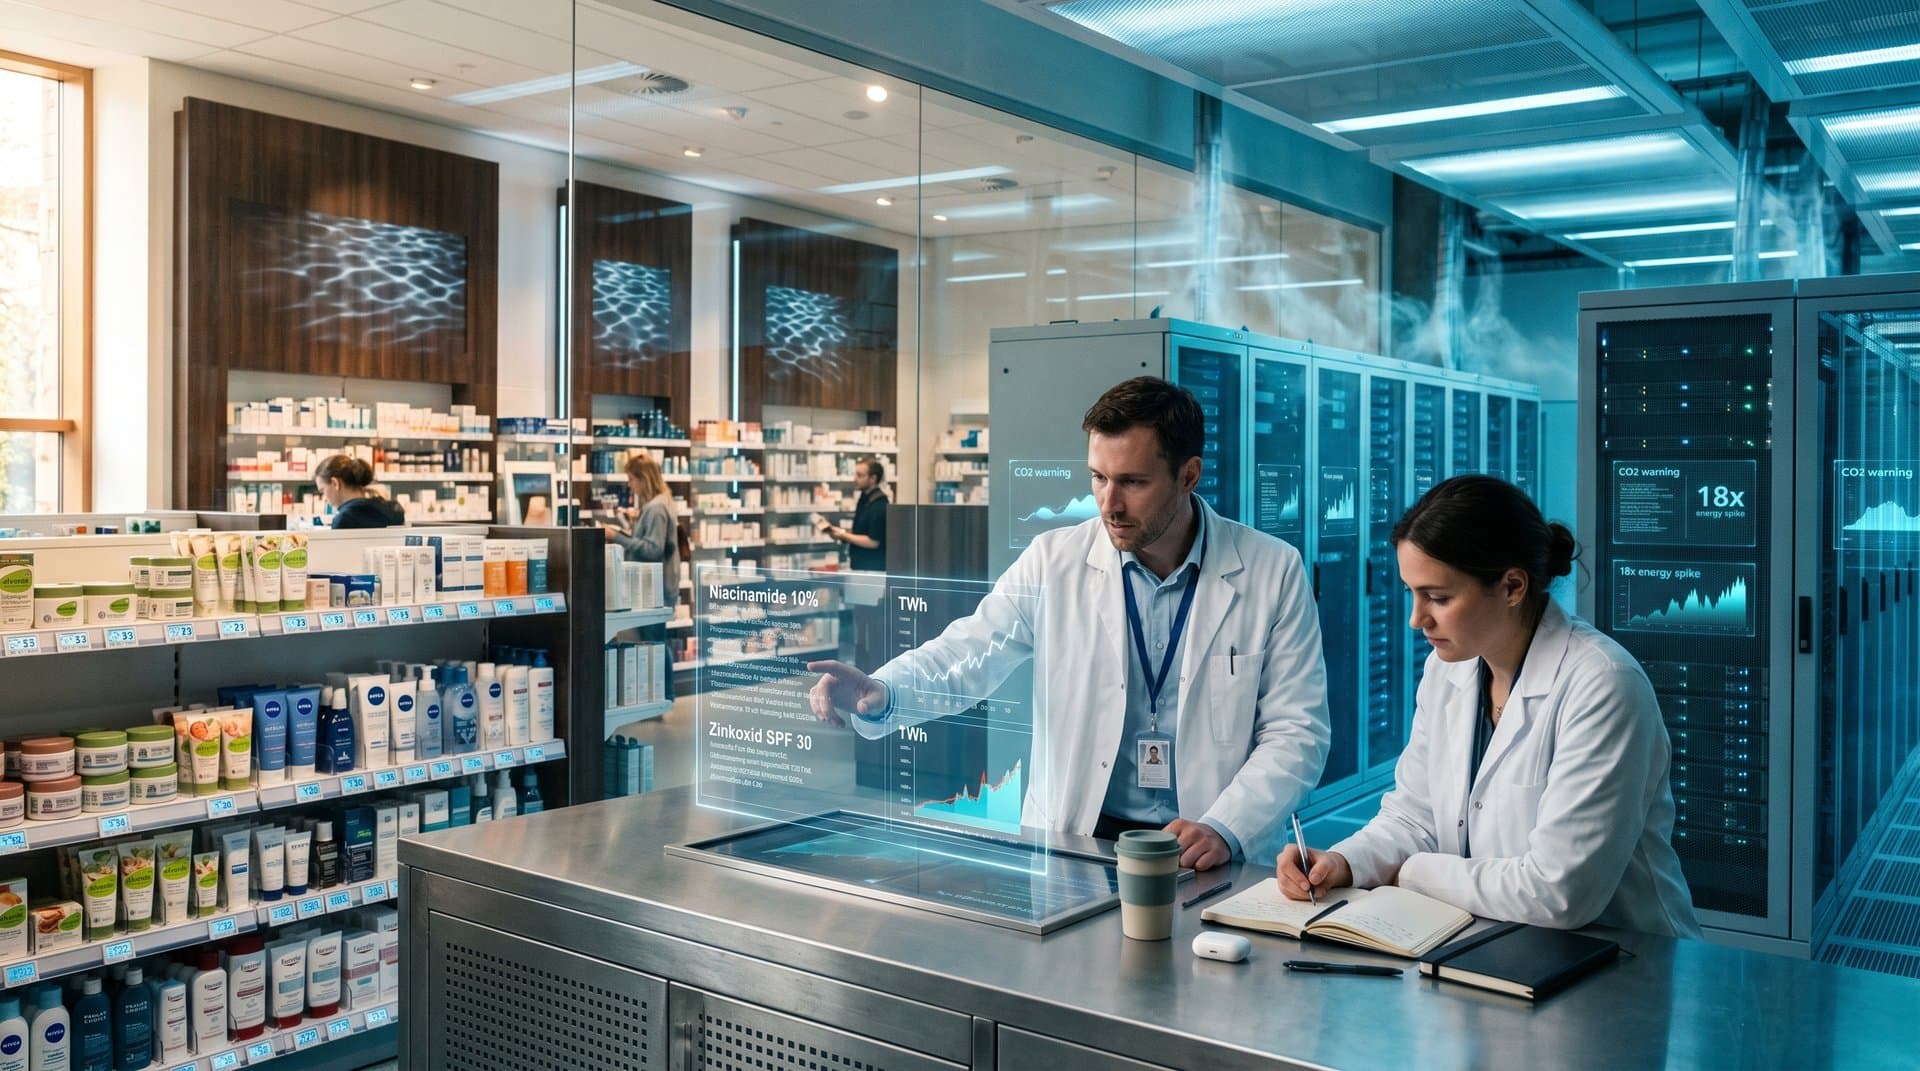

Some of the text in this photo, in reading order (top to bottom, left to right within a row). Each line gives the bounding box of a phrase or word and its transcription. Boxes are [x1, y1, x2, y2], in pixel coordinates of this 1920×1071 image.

[1014, 467, 1072, 480] CO2 warning
[1618, 467, 1680, 478] CO2 warning
[1841, 468, 1913, 480] CO2 warning
[1697, 485, 1745, 508] 18x
[1695, 510, 1745, 519] energy spike
[1620, 567, 1701, 580] 18x energy spike
[709, 584, 819, 608] Niacinamide 10%
[898, 596, 928, 613] TWh
[709, 721, 763, 743] Zinkoxid
[766, 730, 793, 747] SPF
[796, 734, 813, 751] 30
[898, 725, 928, 743] TWh
